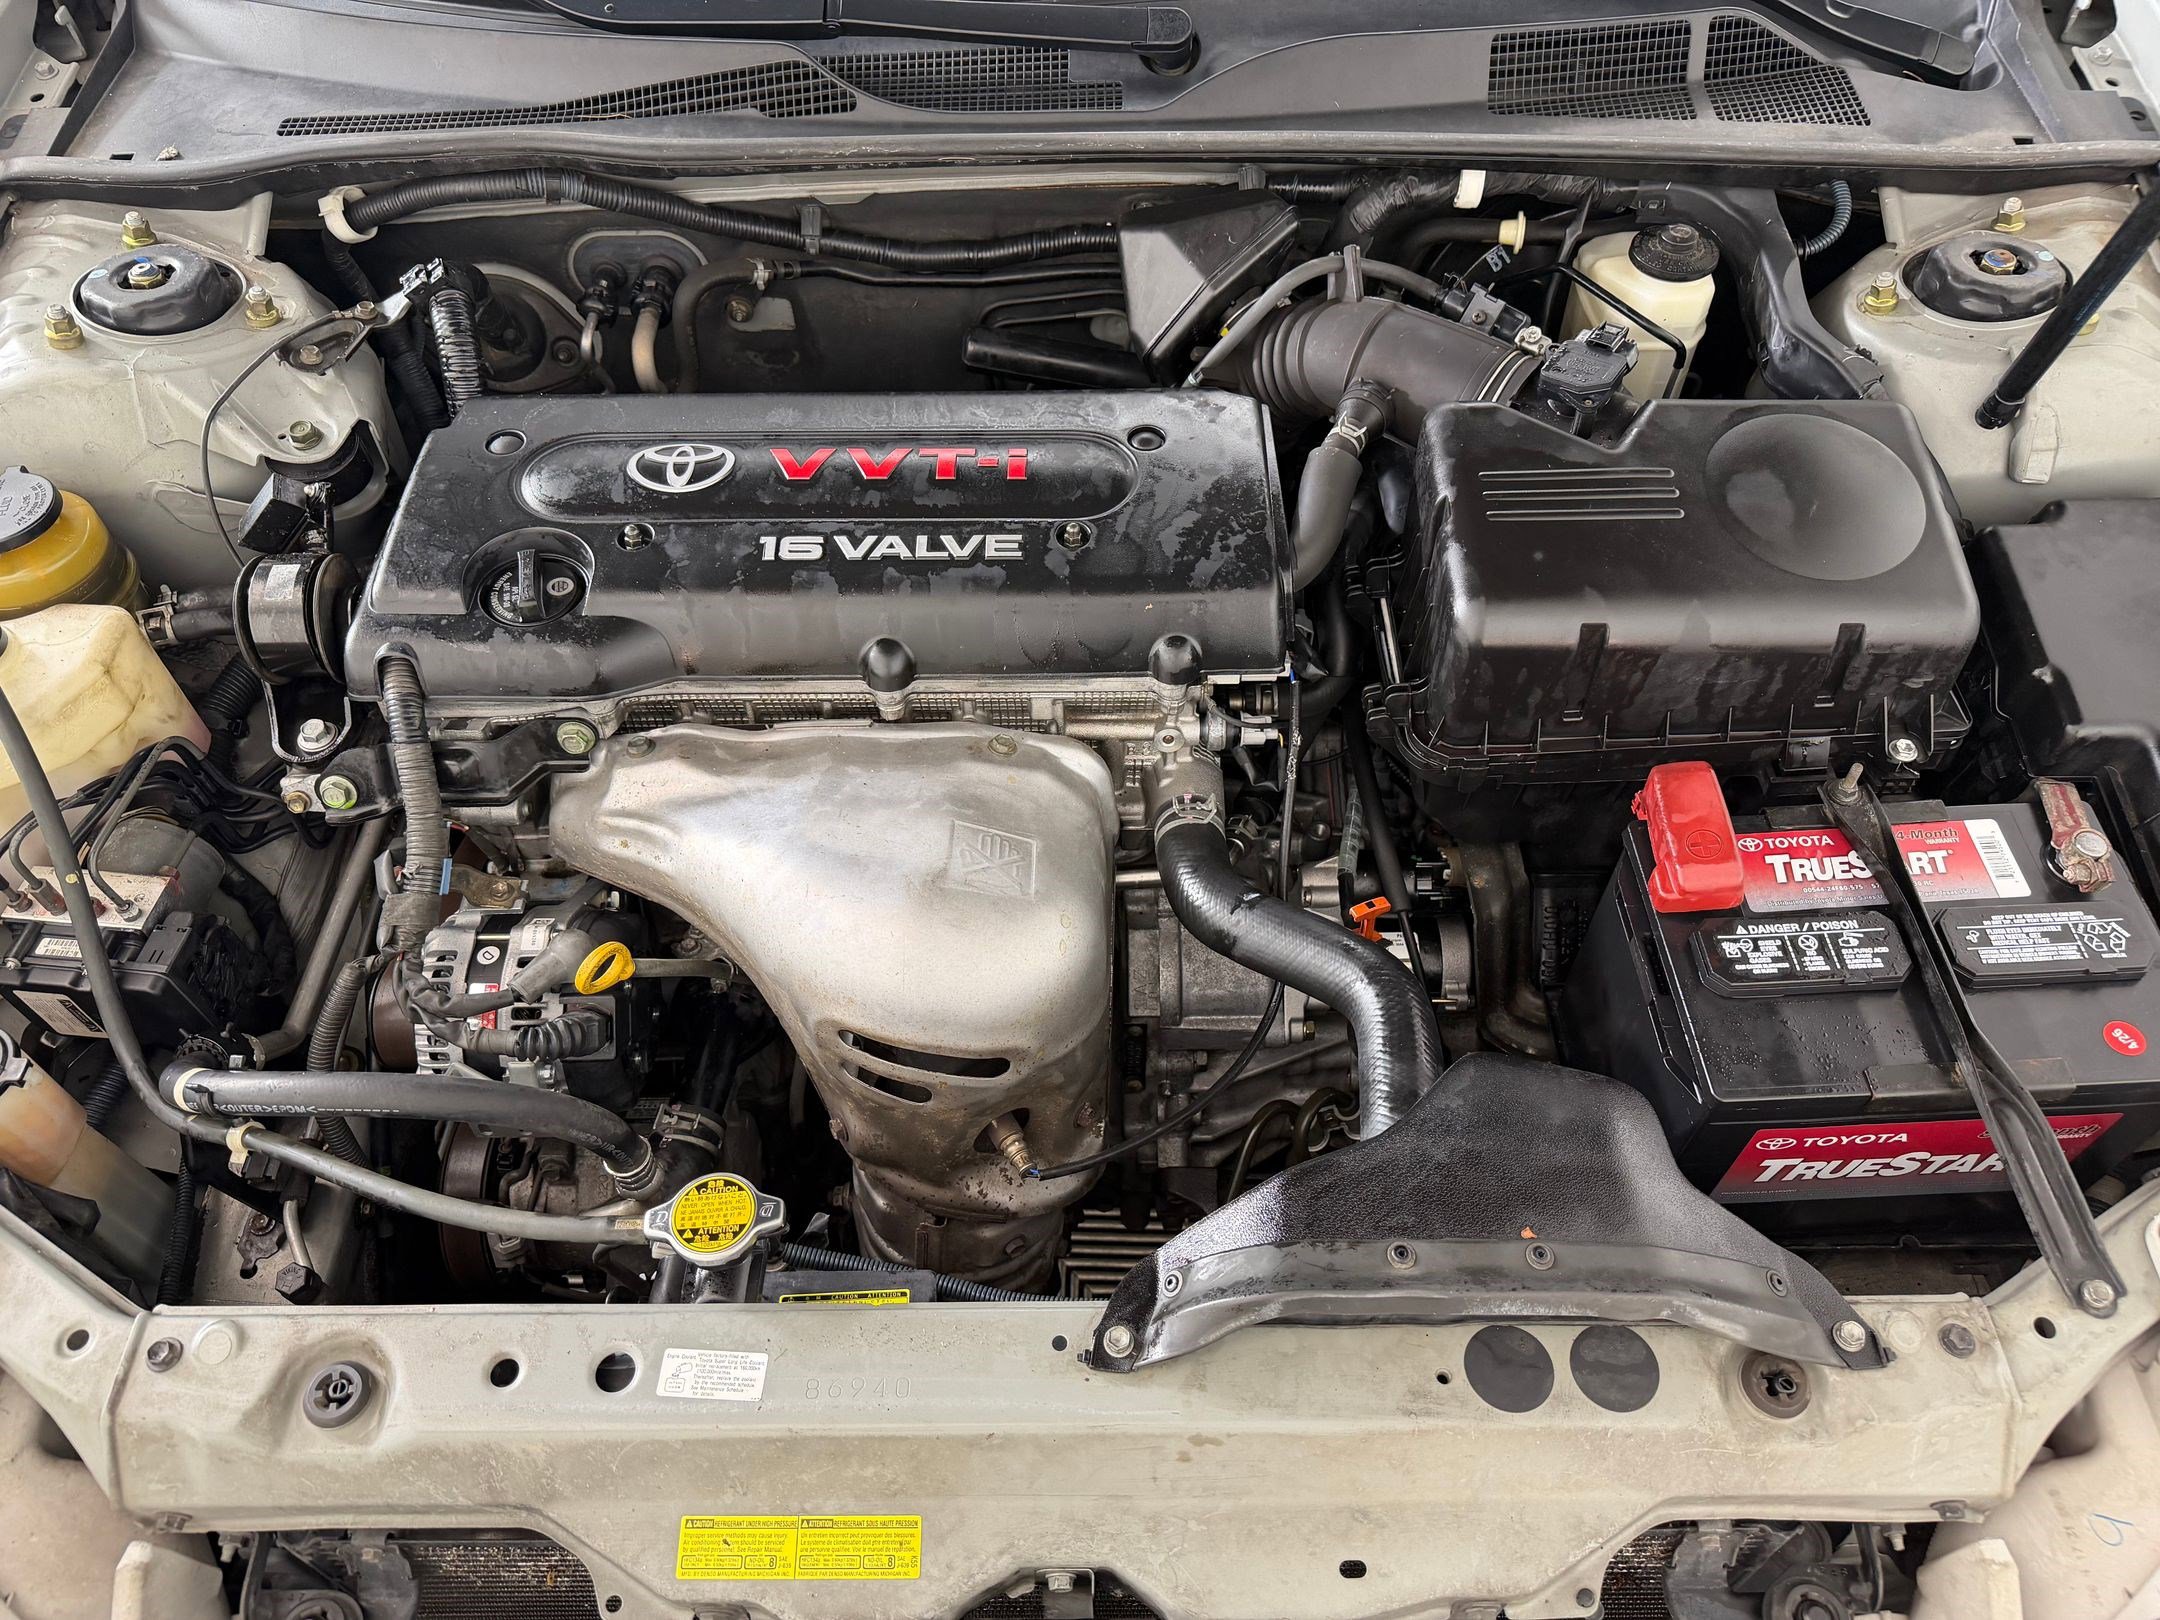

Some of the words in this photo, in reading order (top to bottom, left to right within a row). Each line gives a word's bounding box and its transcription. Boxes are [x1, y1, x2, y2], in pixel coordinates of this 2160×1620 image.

[770, 447, 1028, 480] VVT-i
[760, 536, 824, 561] 16
[833, 535, 1024, 561] VALVE
[1764, 835, 1835, 848] TOYOTA
[1748, 923, 1800, 934] DANGER
[1812, 920, 1859, 931] POISON
[2111, 1028, 2139, 1049] 4/26
[1803, 1133, 1909, 1148] TOYOTA
[700, 1186, 738, 1195] CAUTION
[698, 1225, 740, 1236] ATTENTION
[805, 1377, 912, 1399] 86940
[693, 1519, 714, 1528] CAUTION
[715, 1519, 745, 1528] REFRIGERANT
[746, 1519, 761, 1528] UNDER
[762, 1519, 773, 1528] HIGH
[774, 1519, 798, 1528] PRESSURE
[809, 1519, 833, 1528] ATTENTION
[866, 1519, 878, 1528] SOUS
[880, 1519, 894, 1527] HAUTE
[895, 1519, 918, 1527] PRESSION
[769, 1557, 775, 1568] 8
[887, 1556, 893, 1568] 8
